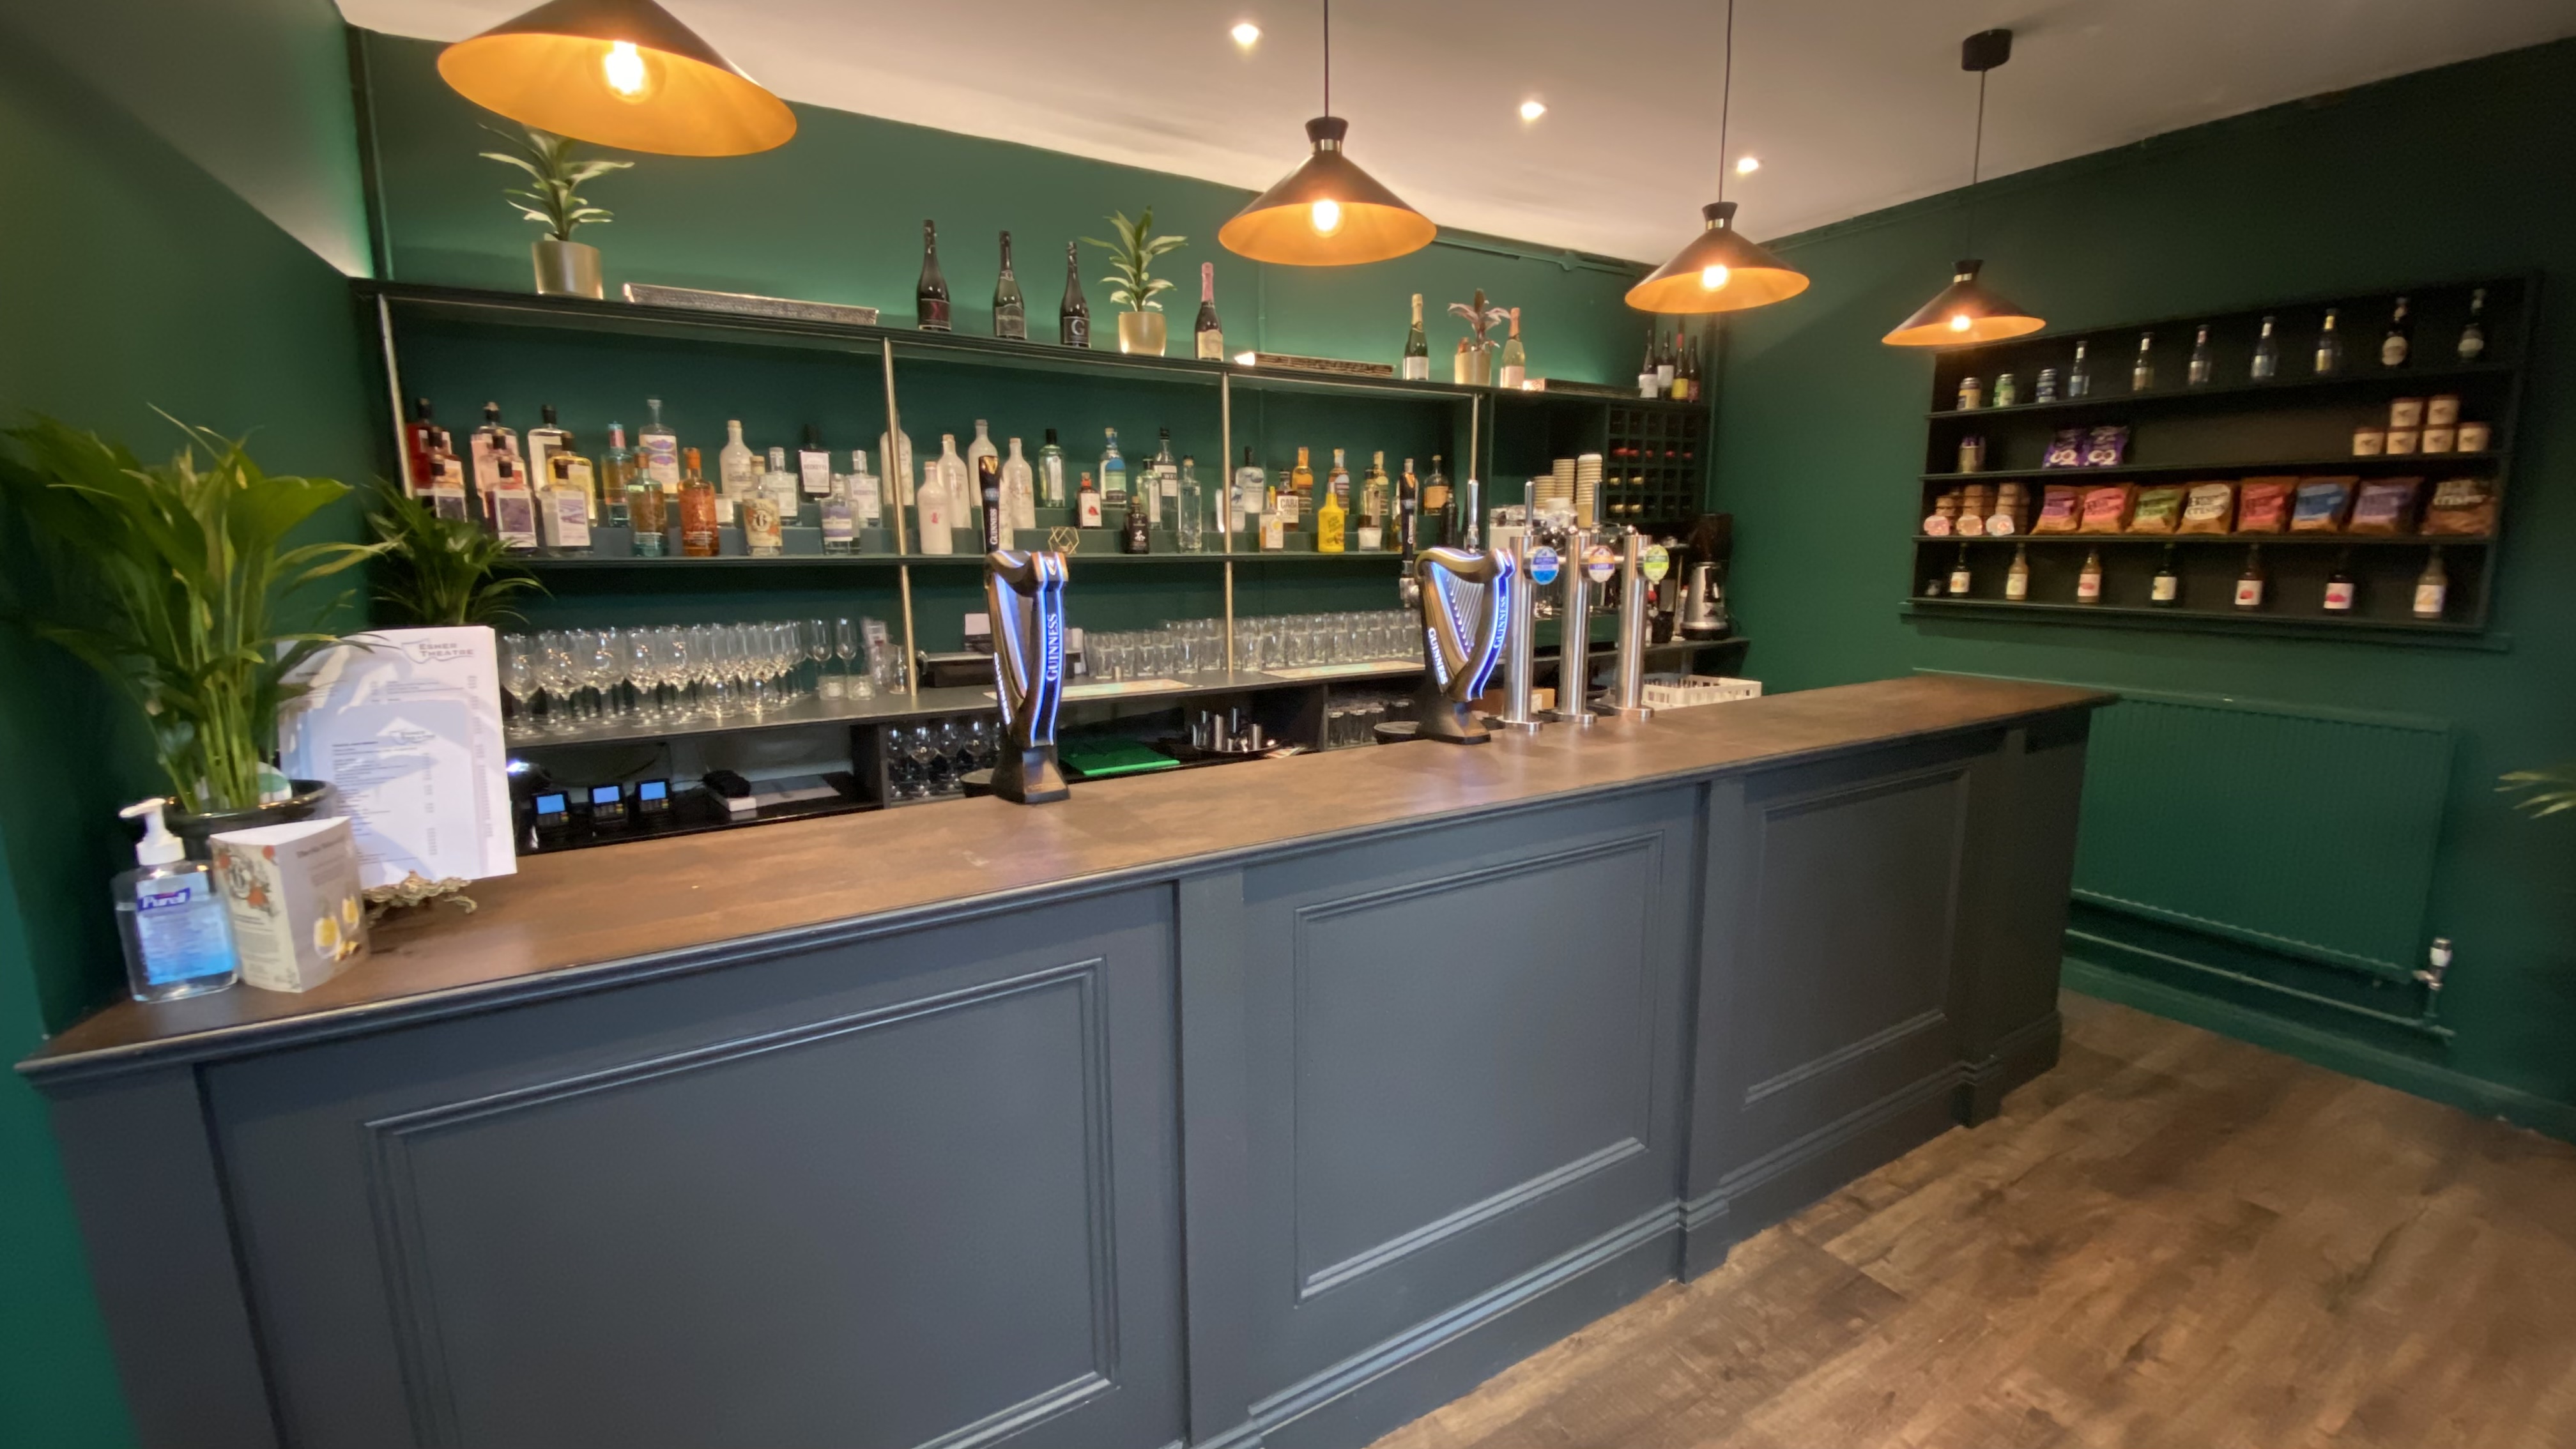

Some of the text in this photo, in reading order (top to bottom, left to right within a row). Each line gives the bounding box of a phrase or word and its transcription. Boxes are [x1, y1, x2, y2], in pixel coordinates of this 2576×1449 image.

[1046, 613, 1059, 682] GUINNESS
[1493, 596, 1506, 648] GUINNESS
[1428, 627, 1448, 684] GUINNESS
